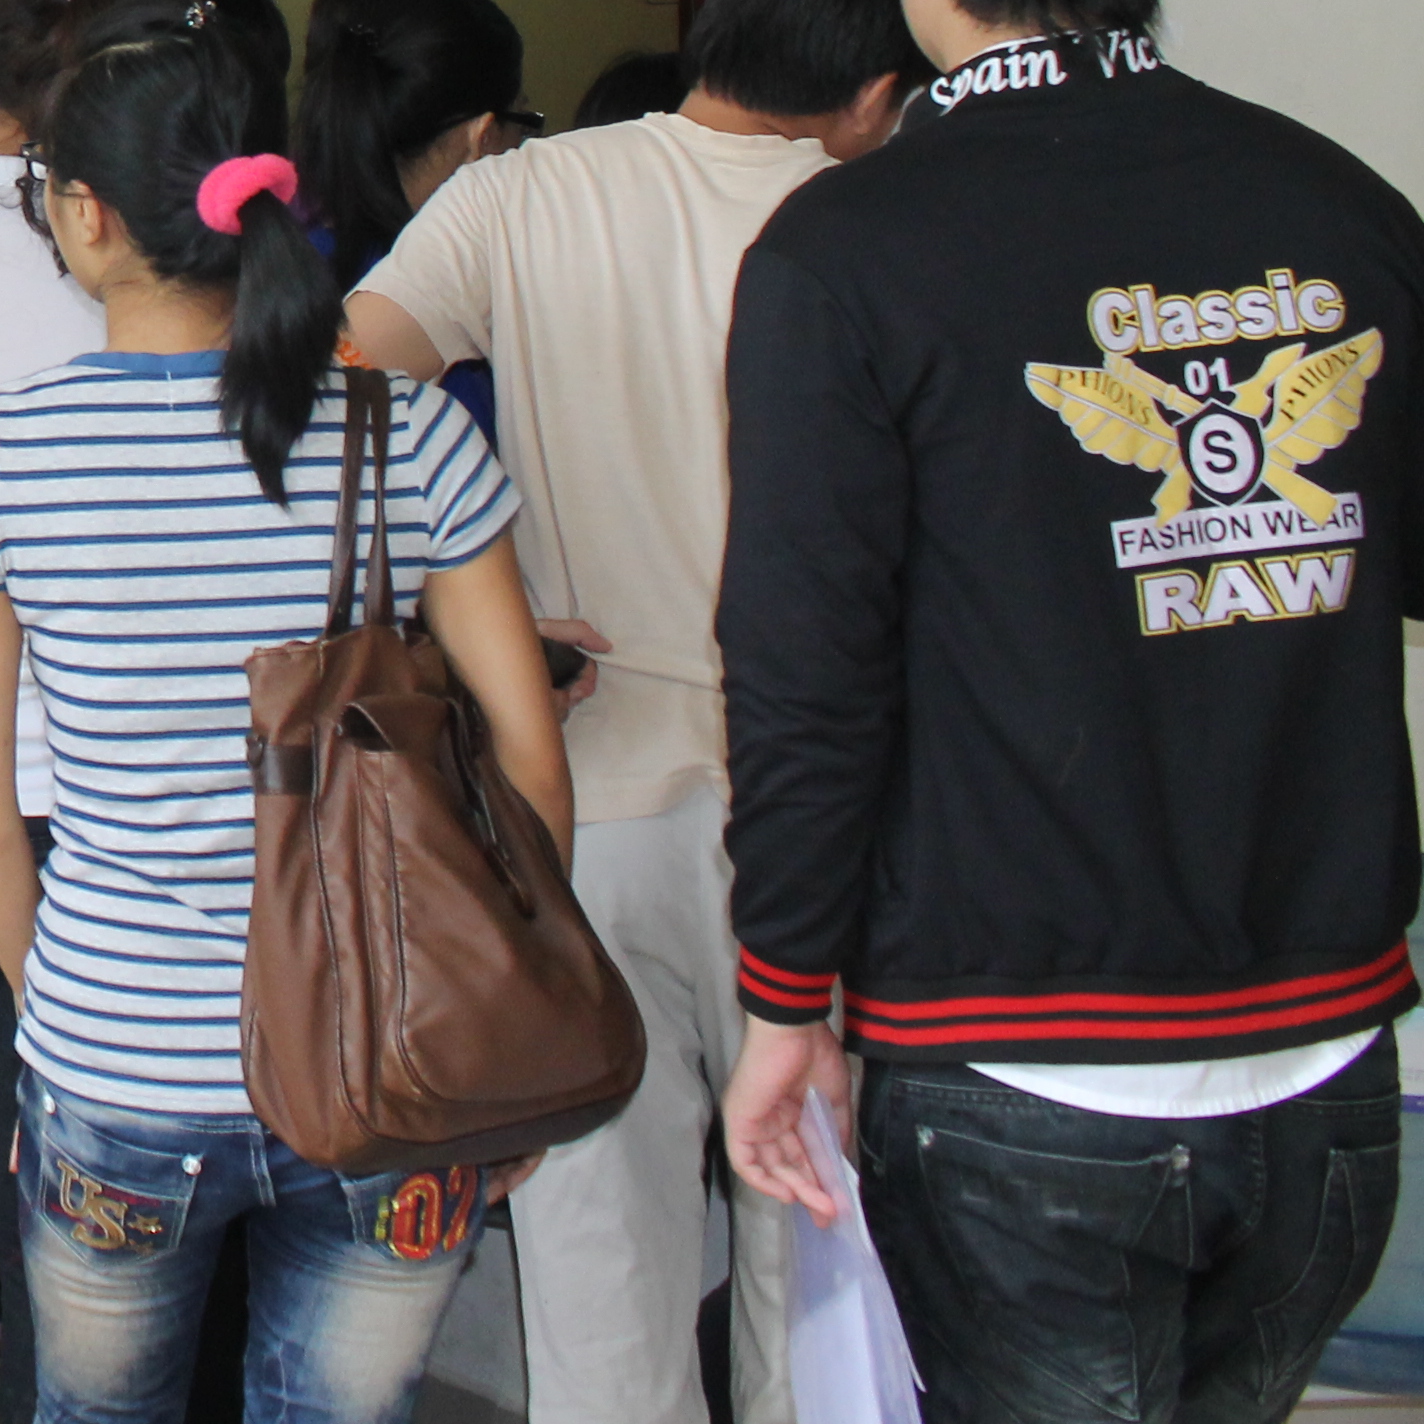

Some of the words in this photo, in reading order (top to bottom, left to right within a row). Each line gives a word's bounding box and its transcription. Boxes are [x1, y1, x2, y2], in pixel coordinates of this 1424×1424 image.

[1087, 268, 1347, 355] Classic
[1184, 358, 1230, 395] 01
[1203, 429, 1238, 473] S
[1118, 513, 1253, 556] FASHION
[1135, 548, 1356, 636] RAW
[57, 1160, 128, 1250] US
